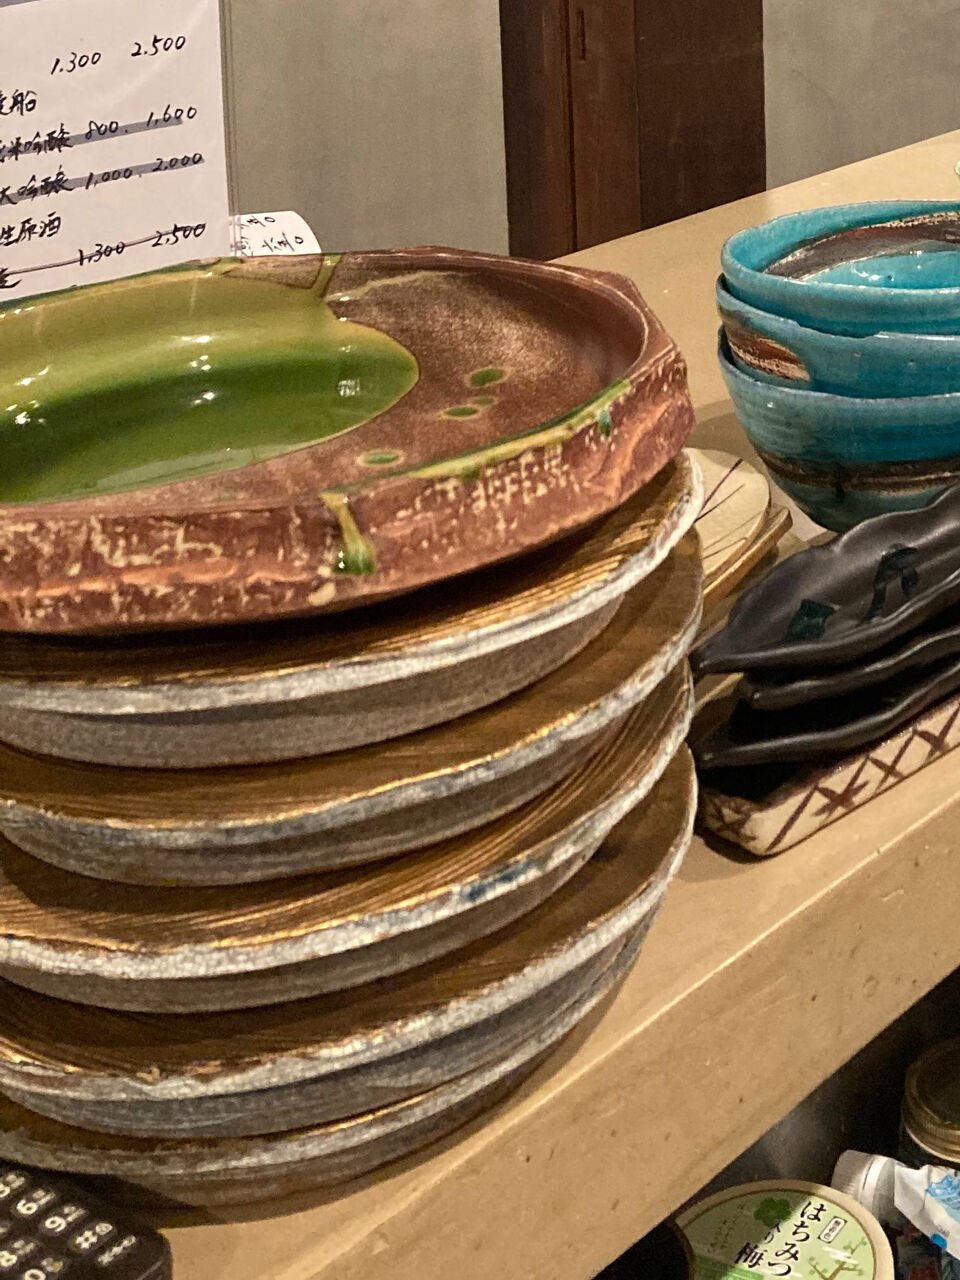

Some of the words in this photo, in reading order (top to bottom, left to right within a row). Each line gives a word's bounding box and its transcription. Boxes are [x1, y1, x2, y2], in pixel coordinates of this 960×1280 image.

[0, 122, 74, 162] 米吟醸
[767, 1201, 828, 1276] はちみつ
